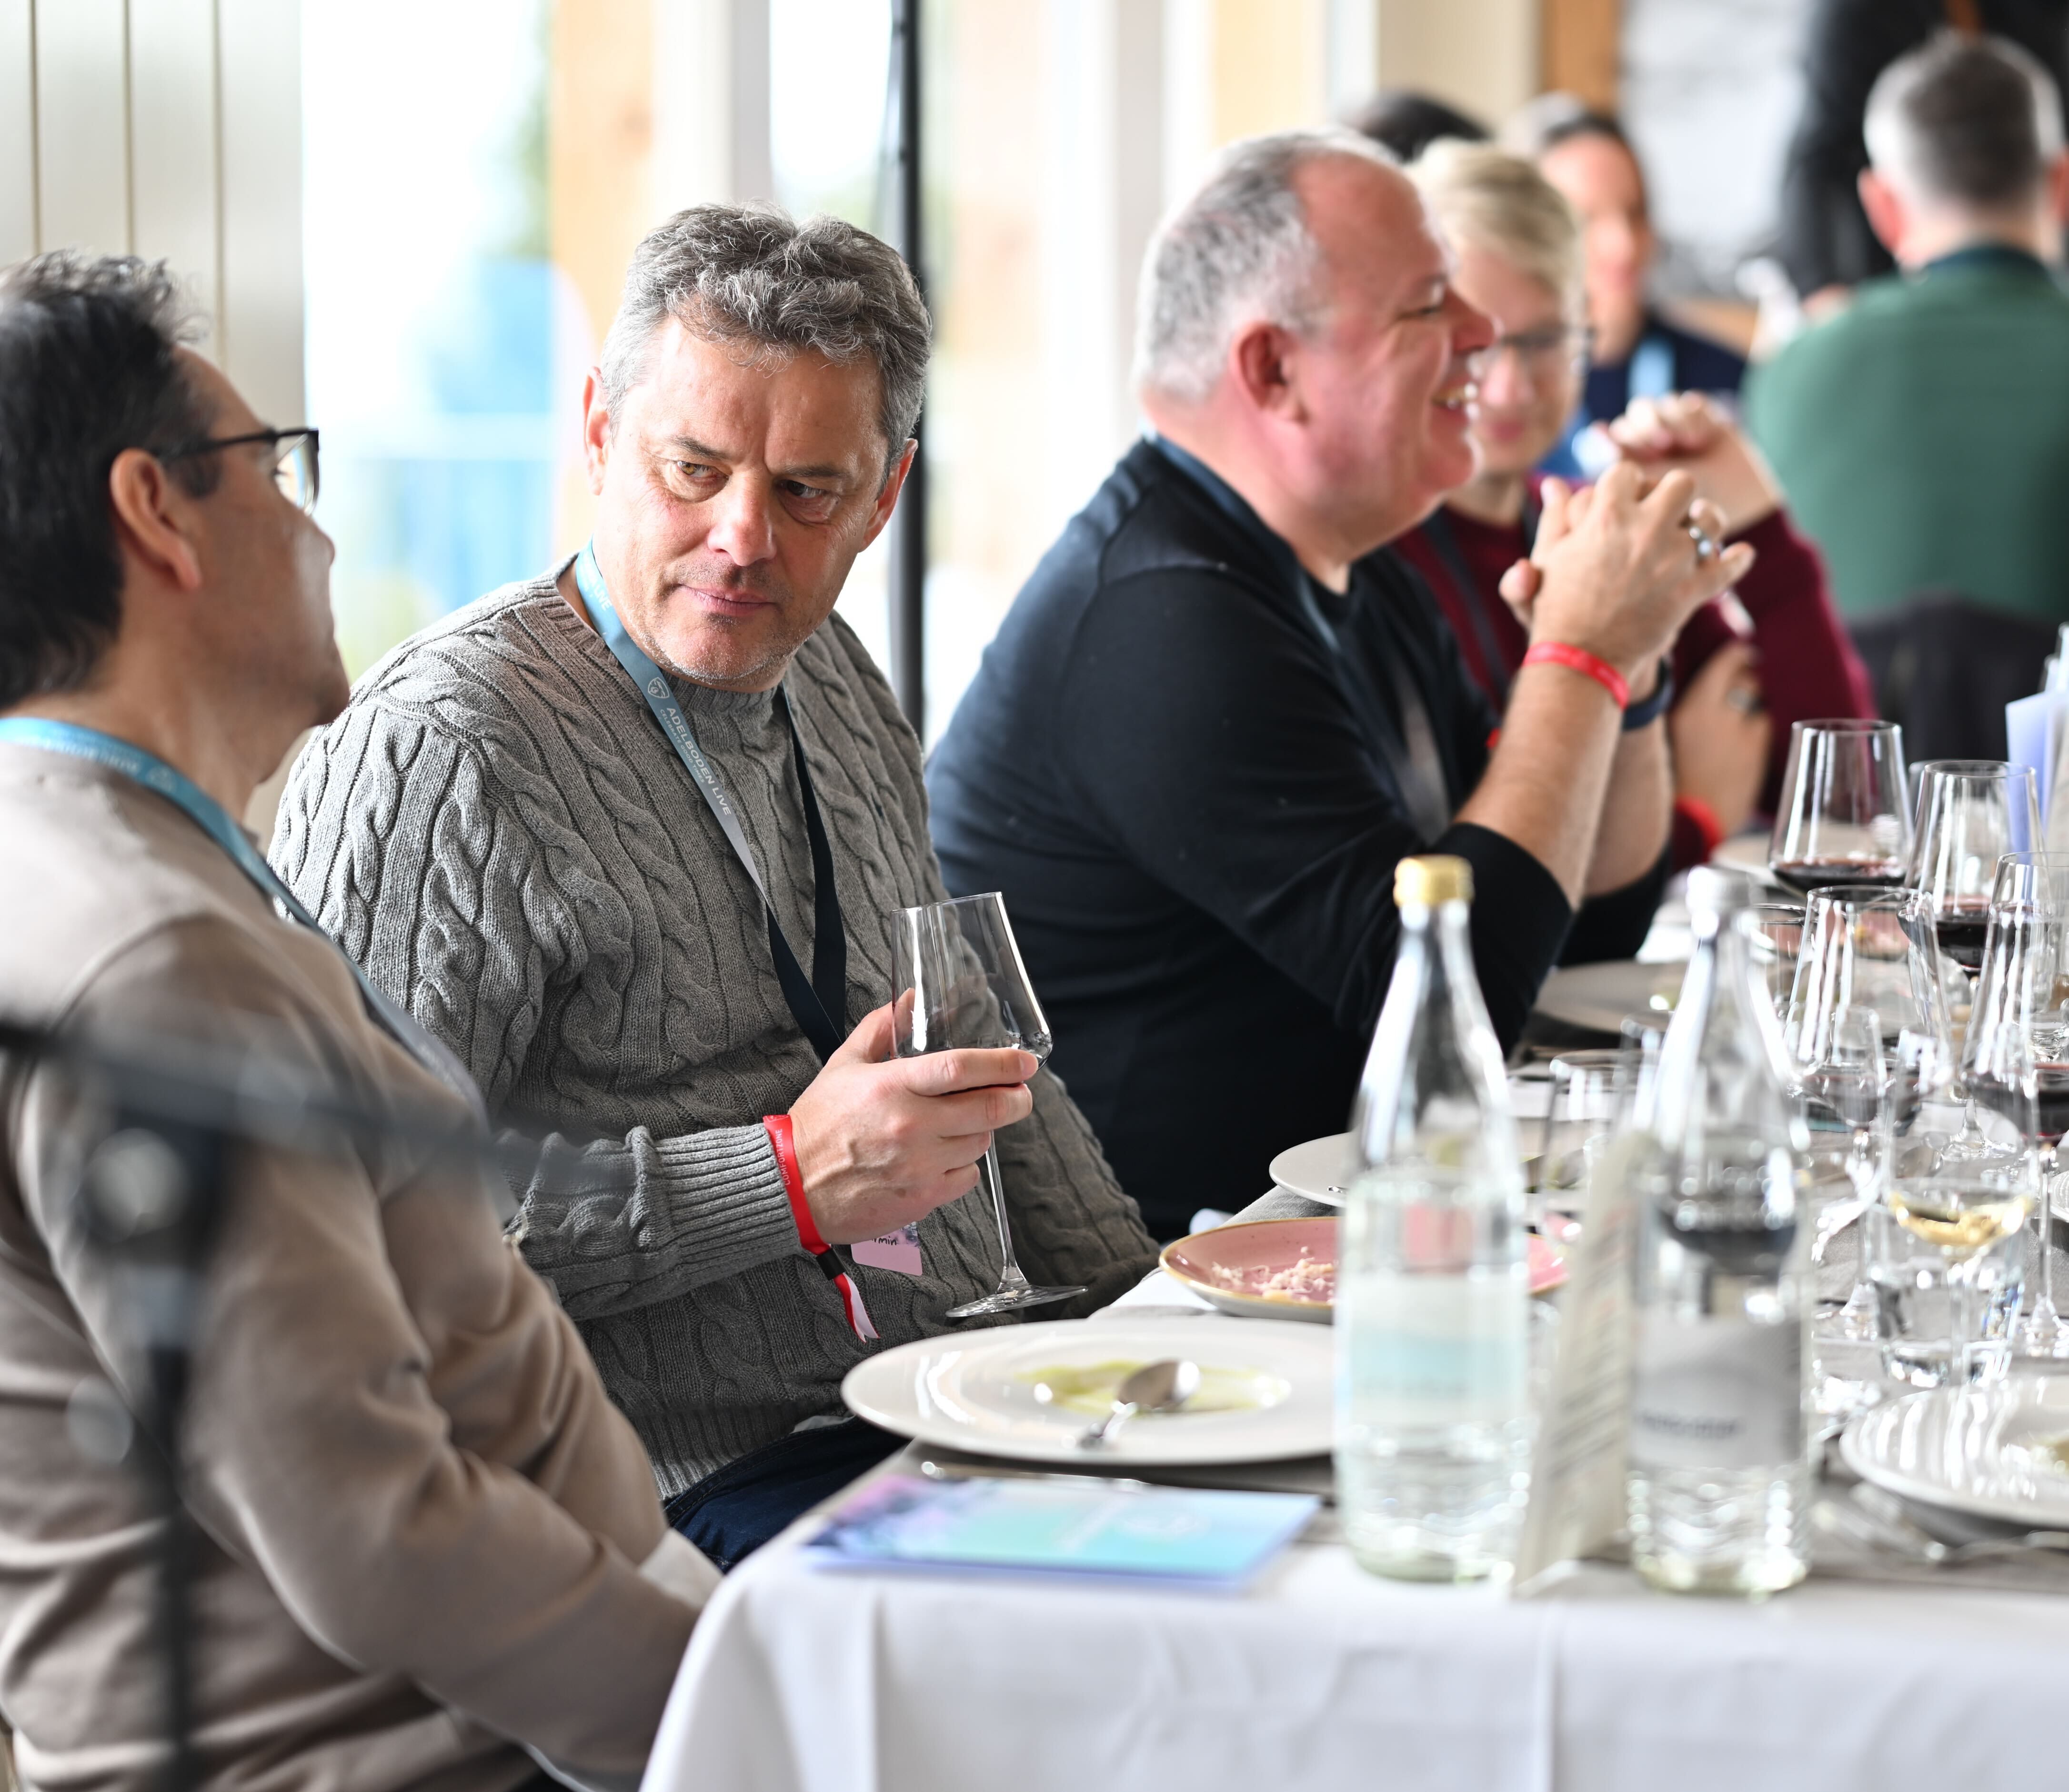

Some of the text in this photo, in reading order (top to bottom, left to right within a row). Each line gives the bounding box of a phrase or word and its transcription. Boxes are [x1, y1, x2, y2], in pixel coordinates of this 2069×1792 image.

[660, 709, 704, 783] CELEBRATE GOOD TIMES
[667, 707, 732, 815] ADELBODEN LIVE
[872, 1236, 897, 1246] rmin
